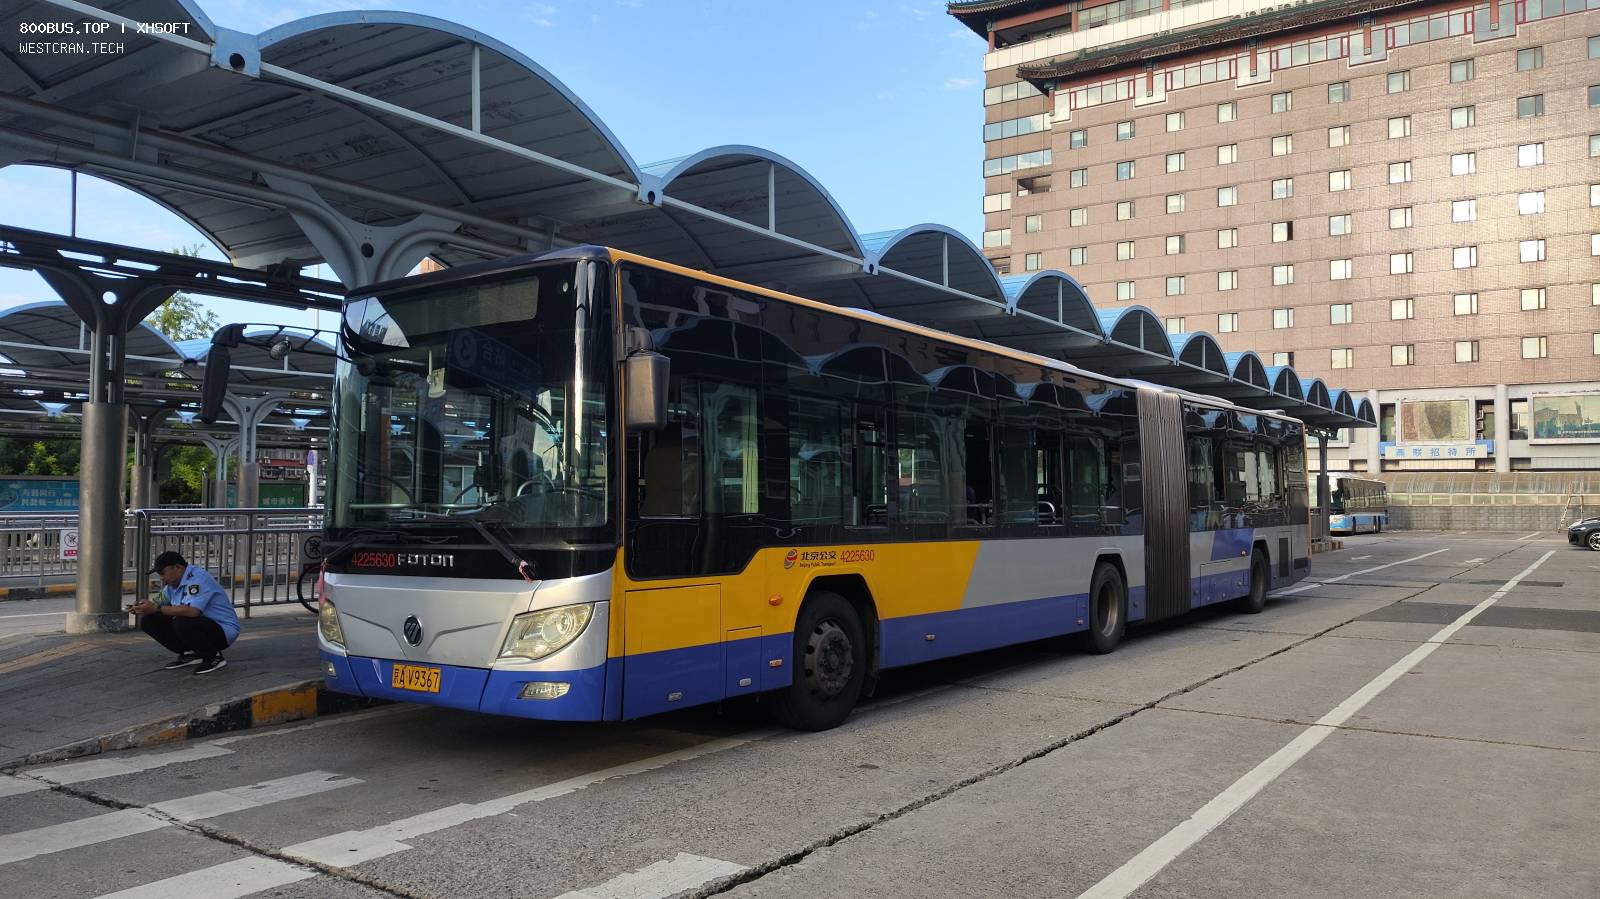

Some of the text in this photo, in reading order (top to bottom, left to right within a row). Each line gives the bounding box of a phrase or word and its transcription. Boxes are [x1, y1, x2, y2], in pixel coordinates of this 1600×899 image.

[352, 551, 454, 568] 4225630 FOTON
[801, 549, 875, 563] 北京公交 4225630
[394, 667, 440, 689] 京AV9367
